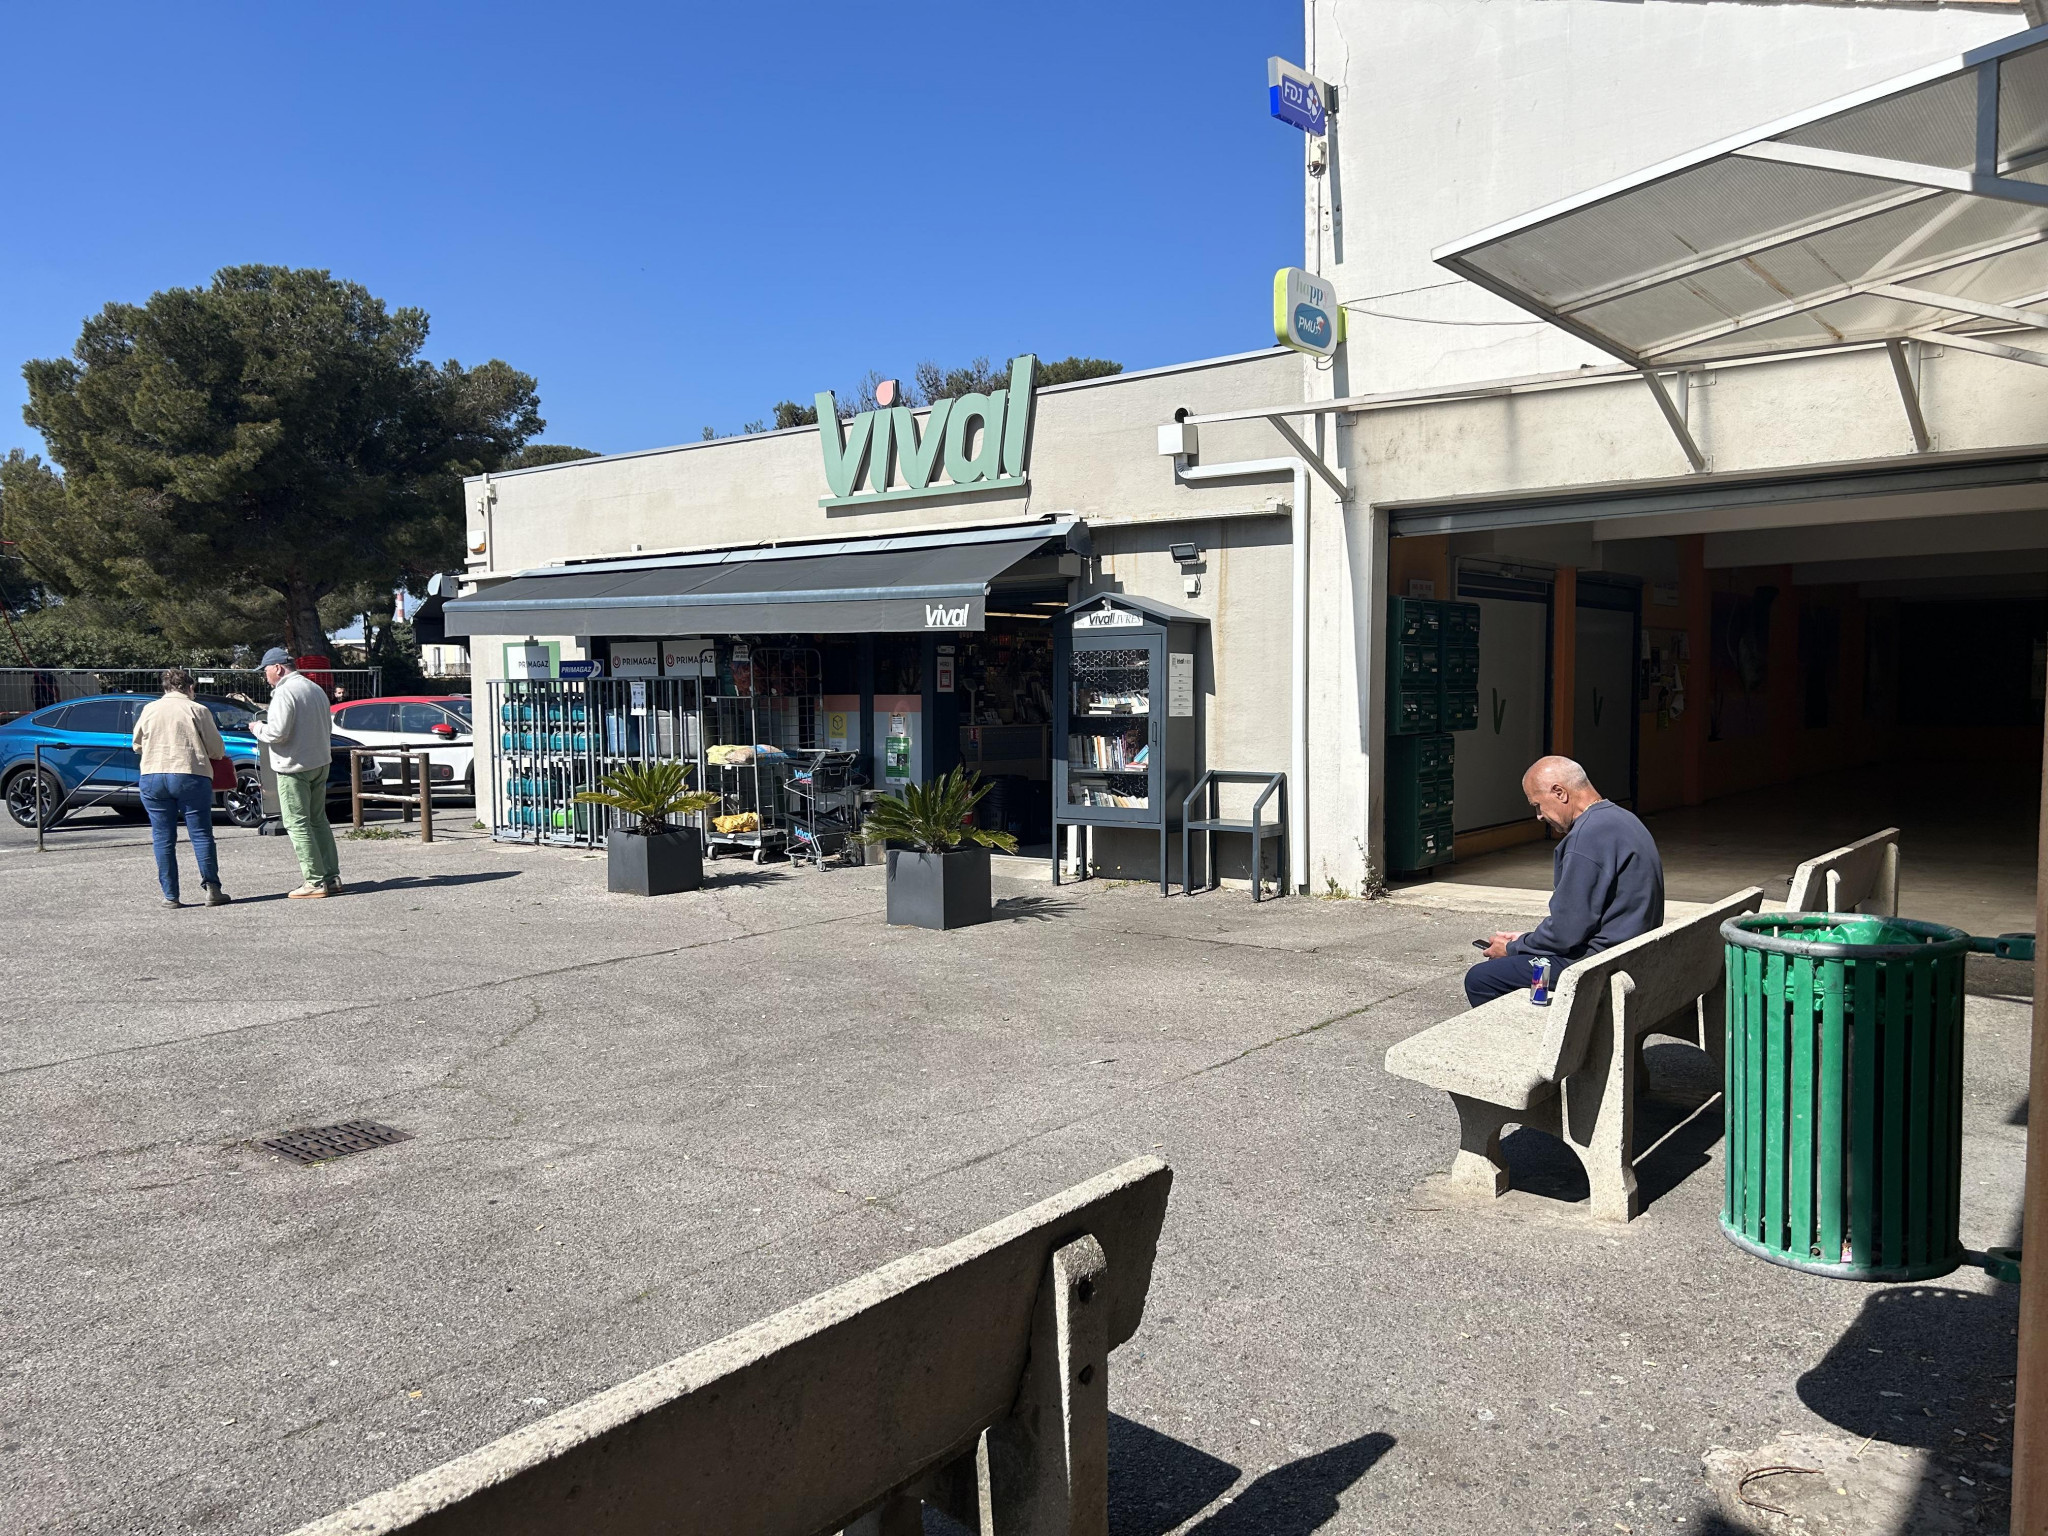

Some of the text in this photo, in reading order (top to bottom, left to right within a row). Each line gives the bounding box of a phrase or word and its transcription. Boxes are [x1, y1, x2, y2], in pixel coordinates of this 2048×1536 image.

[1284, 81, 1303, 104] FDJ
[1296, 272, 1329, 307] happy
[1298, 315, 1316, 334] PMU
[814, 353, 1036, 502] Vival
[924, 603, 970, 628] Vival
[622, 657, 657, 666] PRIMAGAZ
